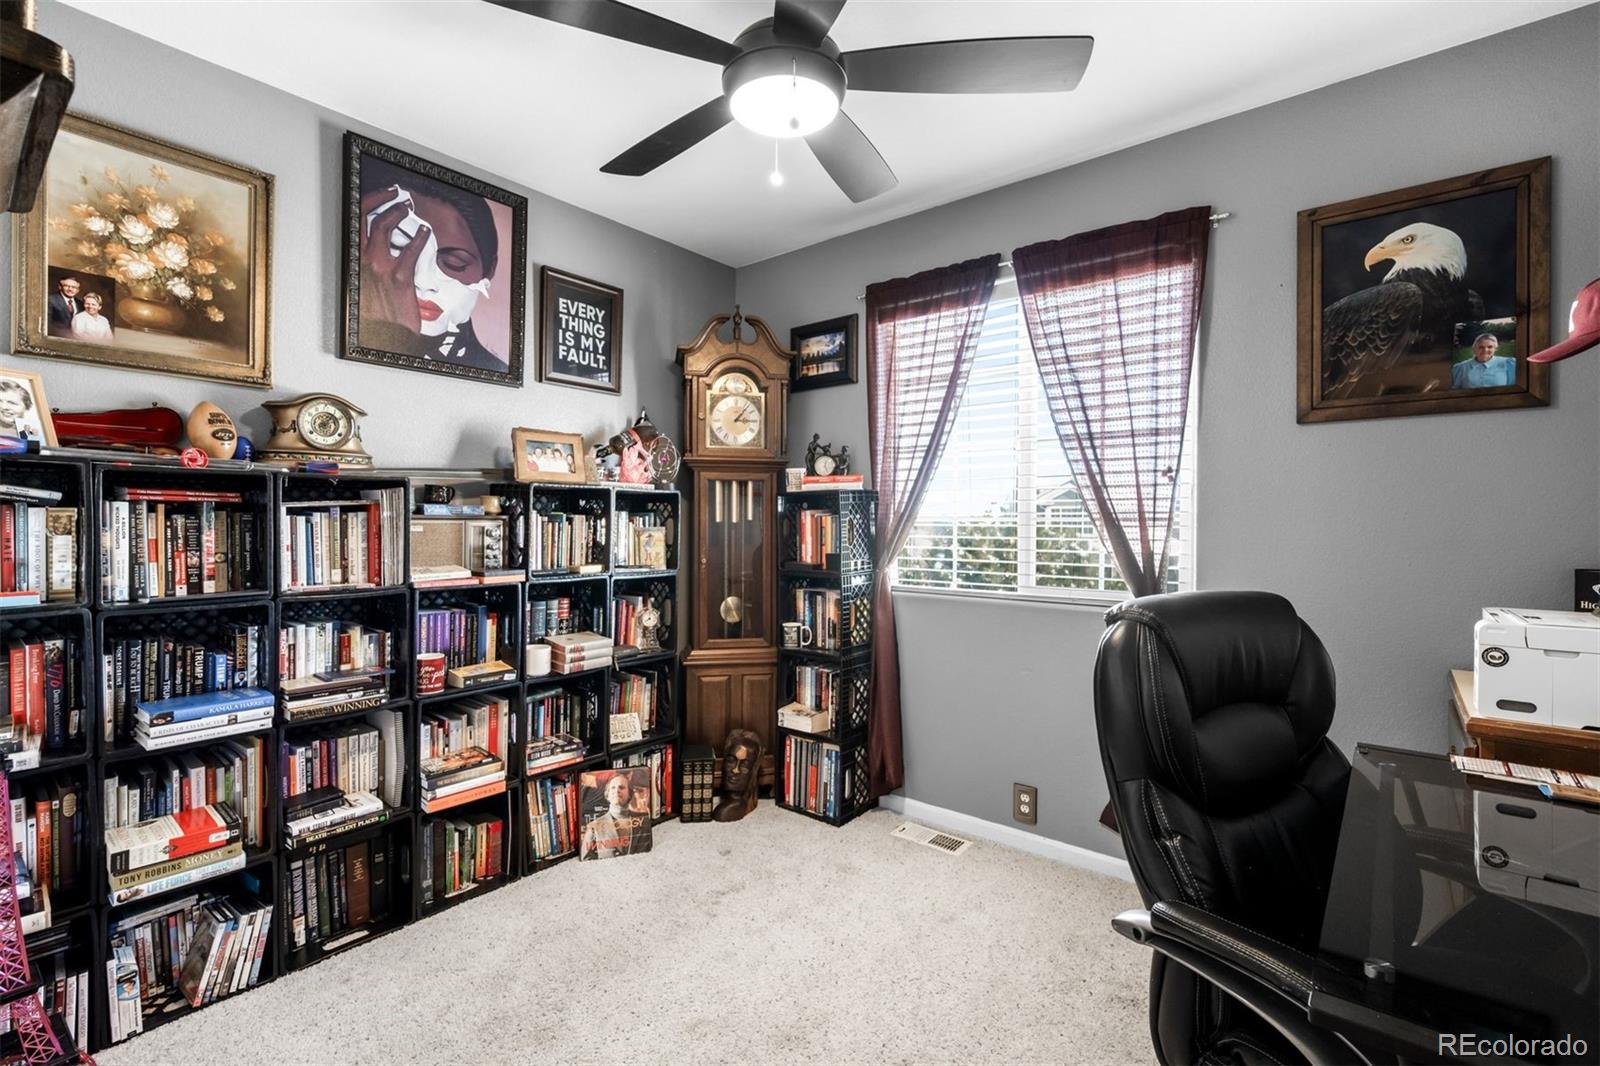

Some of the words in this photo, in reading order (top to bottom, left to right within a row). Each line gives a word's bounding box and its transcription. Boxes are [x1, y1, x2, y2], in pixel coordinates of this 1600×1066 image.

[559, 298, 605, 323] EVERY
[559, 314, 605, 338] THING
[560, 329, 575, 346] IS
[581, 335, 605, 354] MY
[559, 346, 607, 370] FAULT.
[136, 505, 144, 535] BEYOND
[137, 538, 145, 563] ORDER
[35, 564, 40, 573] OF
[47, 664, 63, 688] 1776
[130, 660, 136, 668] TO
[194, 650, 204, 678] TRUMP
[208, 704, 238, 714] KAMALA
[239, 700, 265, 709] HARRIS
[333, 698, 380, 712] WINNING
[306, 831, 327, 842] DEATH
[336, 822, 357, 834] SILENT
[358, 817, 379, 827] PLACES
[119, 873, 142, 886] TONY
[145, 862, 182, 878] ROBBINS
[185, 850, 224, 867] MONEY
[147, 881, 164, 894] LIFE
[165, 873, 192, 888] FORCE
